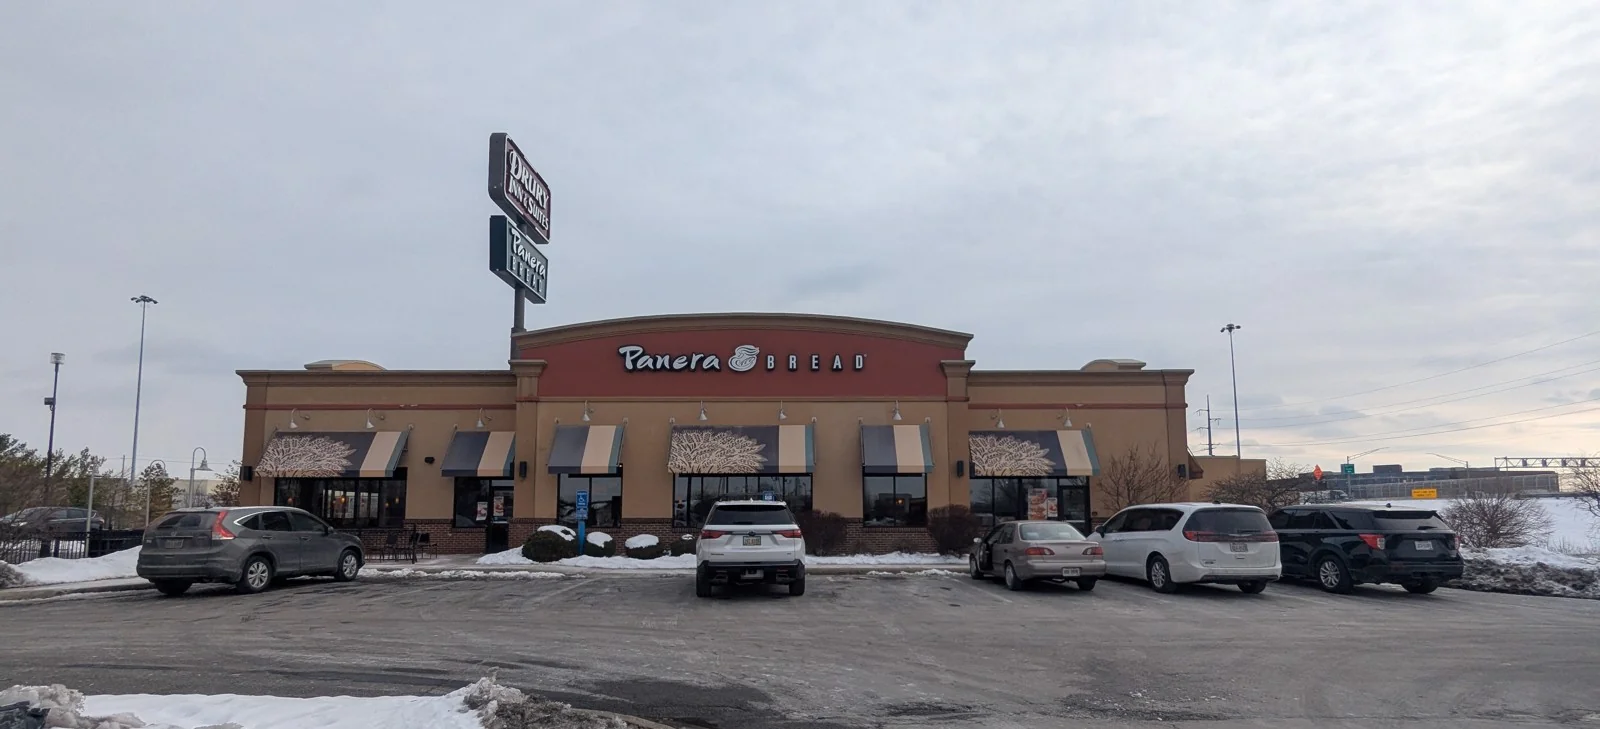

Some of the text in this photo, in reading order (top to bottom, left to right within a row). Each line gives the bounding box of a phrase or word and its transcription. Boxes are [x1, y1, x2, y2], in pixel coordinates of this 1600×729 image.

[509, 150, 549, 208] DRURY
[509, 175, 523, 203] INN
[528, 197, 549, 230] SUITES
[511, 227, 546, 279] Panera
[618, 345, 864, 371] Panera BREAD
